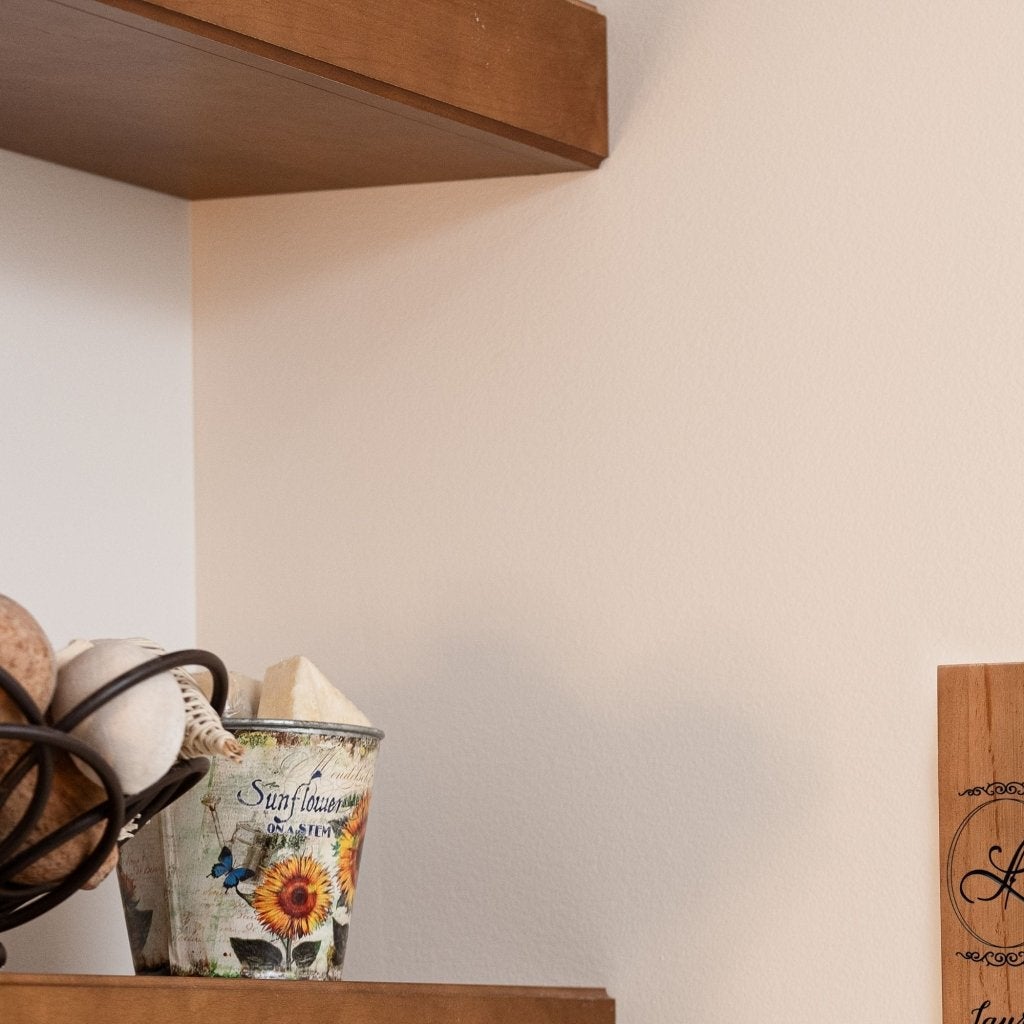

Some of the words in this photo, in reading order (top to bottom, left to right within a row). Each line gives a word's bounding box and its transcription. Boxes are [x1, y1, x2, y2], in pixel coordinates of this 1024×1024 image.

[237, 771, 342, 823] Sunflower
[267, 824, 283, 834] ON
[287, 825, 294, 834] A
[299, 824, 332, 838] STEM
